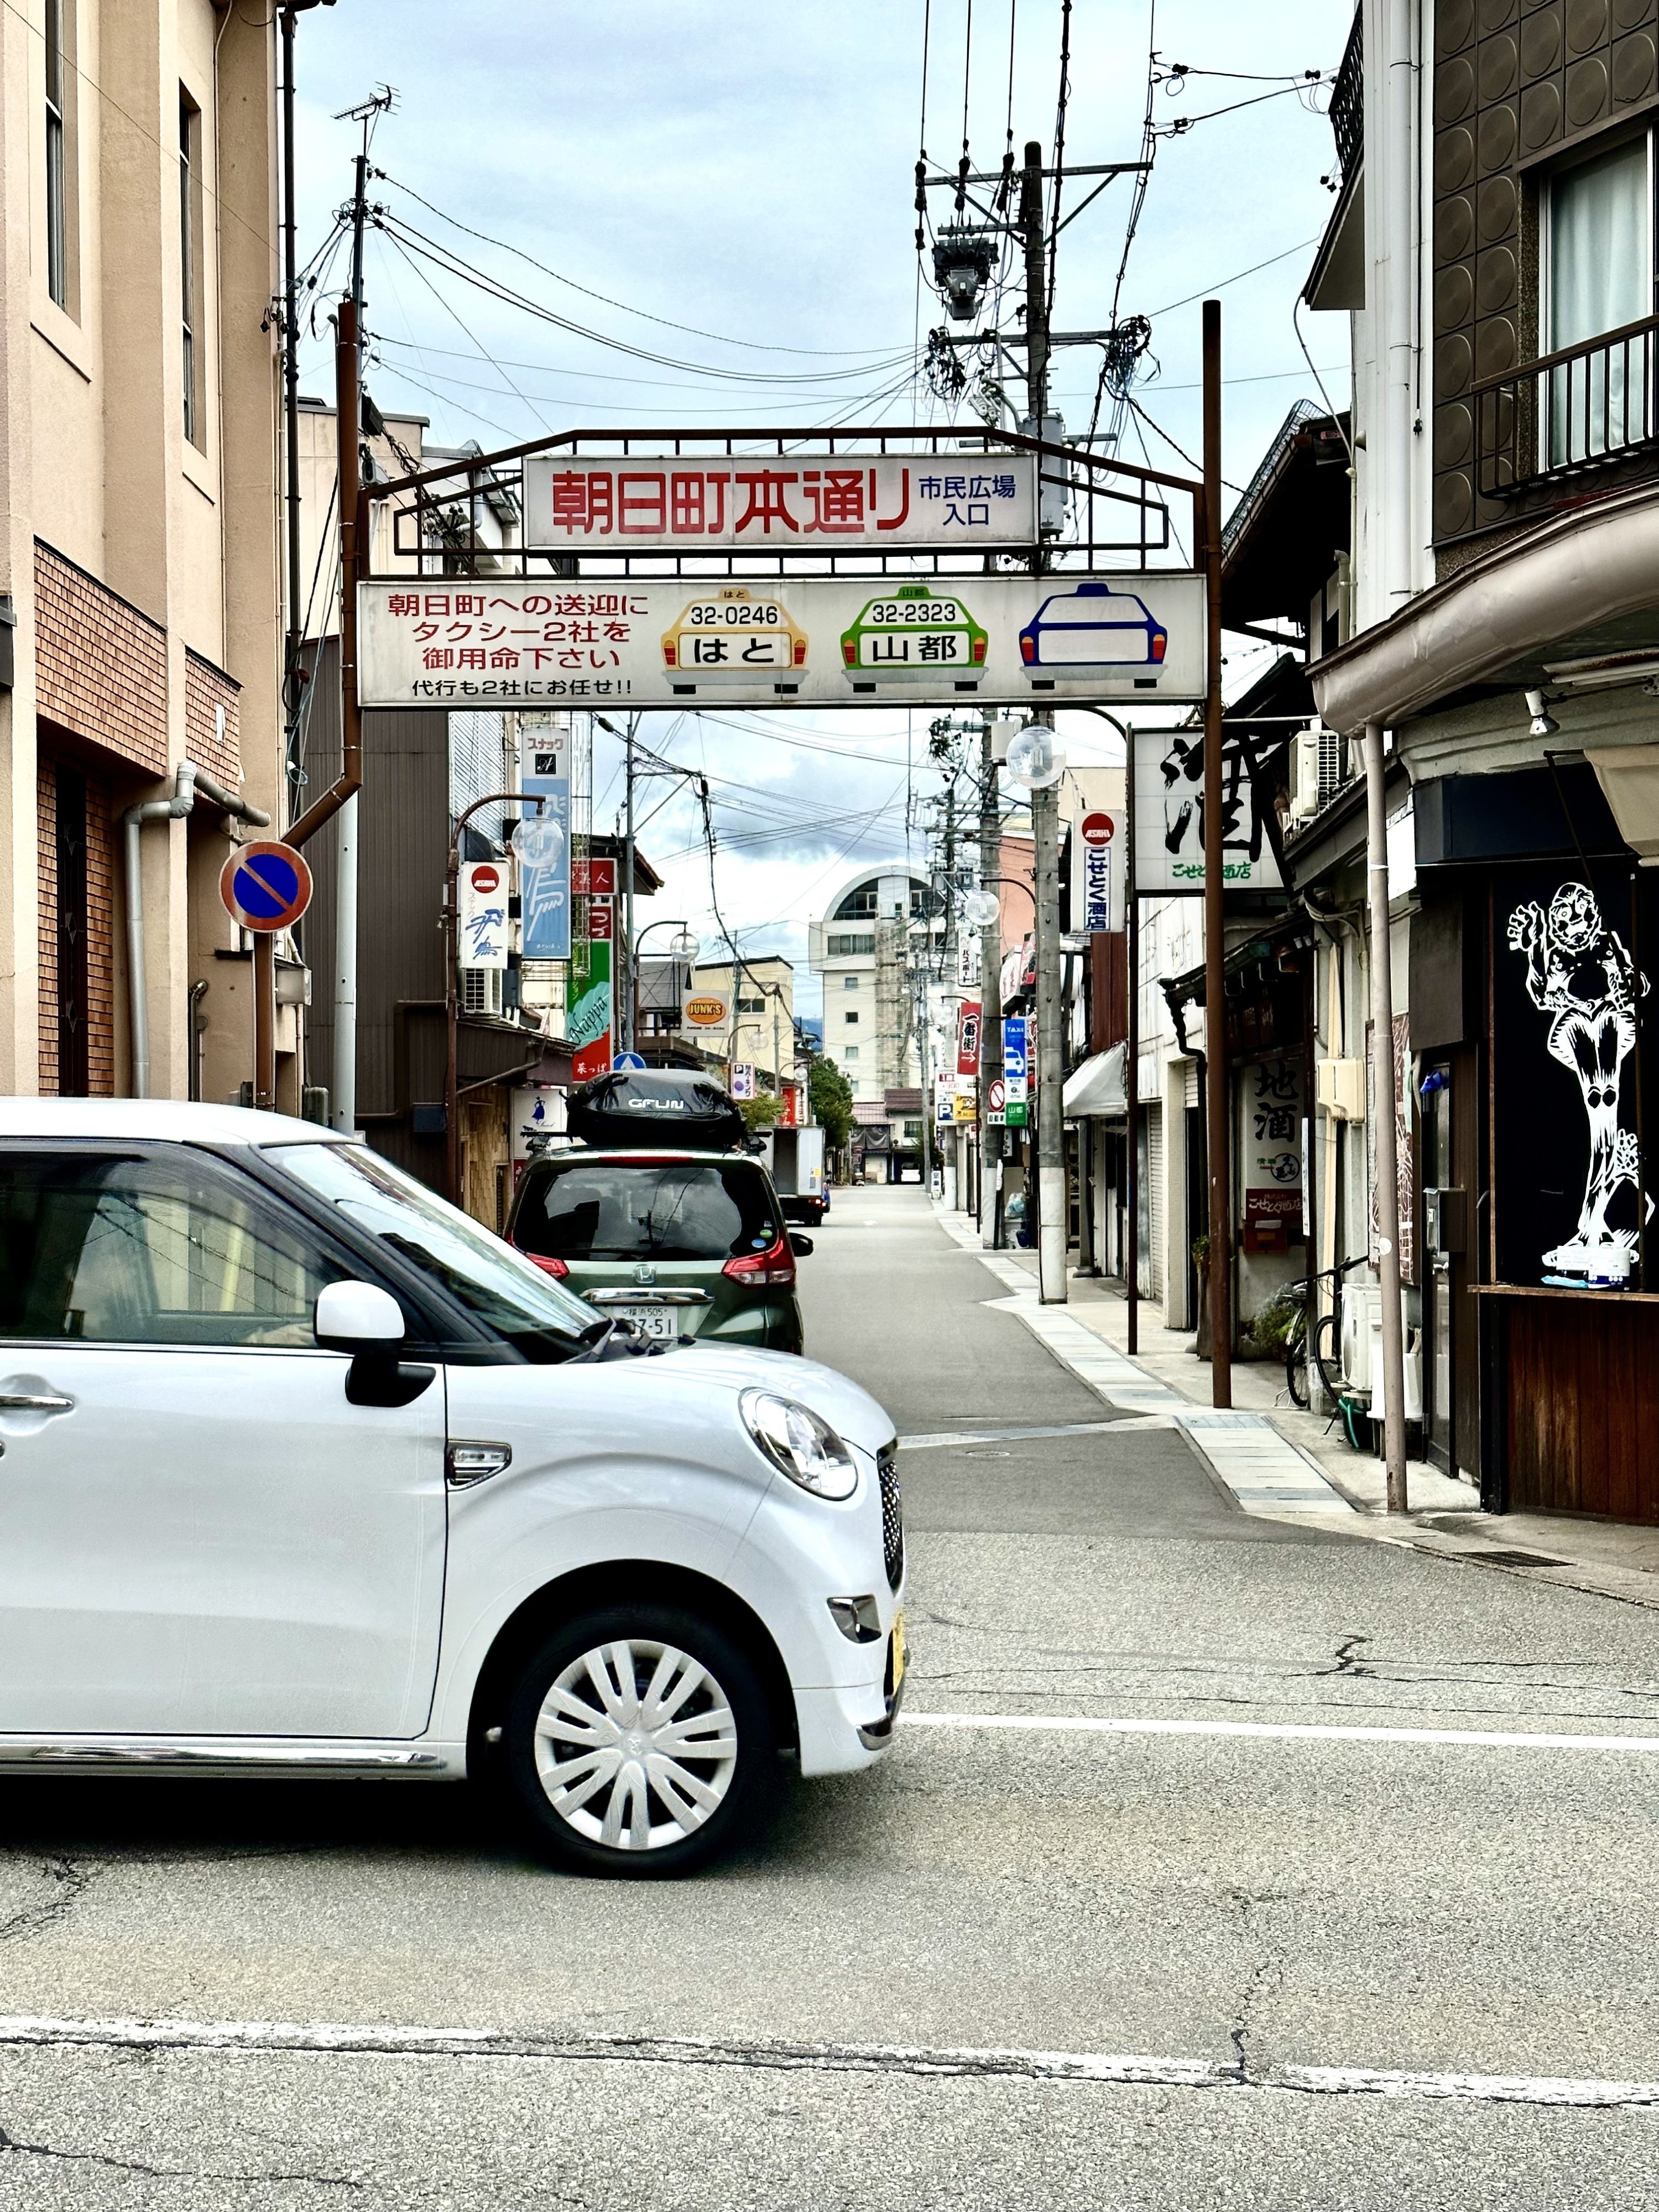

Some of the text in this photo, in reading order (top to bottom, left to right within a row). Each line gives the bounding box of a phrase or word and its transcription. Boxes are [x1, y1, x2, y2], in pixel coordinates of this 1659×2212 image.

[919, 474, 1016, 500] 市民広場
[553, 468, 910, 534] 朝日町本通り
[943, 503, 989, 526] 入口
[723, 591, 745, 599] はと
[902, 588, 925, 597] 山都
[388, 594, 649, 617] 朝日町への送迎に
[691, 606, 778, 625] 32-0246
[872, 603, 956, 623] 32-2323
[413, 621, 630, 643] タクシー2社を
[694, 638, 775, 664] はと
[873, 635, 957, 661] 山都
[422, 647, 620, 671] 御用命下さい
[412, 679, 632, 697] 代行も2社にお任せ!!
[527, 738, 564, 750] スナック
[1160, 737, 1266, 863] 酒
[1085, 829, 1111, 838] ASAHI
[1172, 860, 1252, 879] こせと酒店
[1086, 848, 1108, 929] こせとく酒店
[688, 1003, 722, 1015] JUNK'S
[570, 996, 608, 1044] Nappa
[962, 1013, 980, 1053] 一番街
[628, 1098, 684, 1110] GFUN
[1253, 1060, 1300, 1143] 地酒
[1248, 1197, 1303, 1215] こせとく酒店
[647, 1308, 663, 1317] 505
[630, 1318, 672, 1334] 7-51
